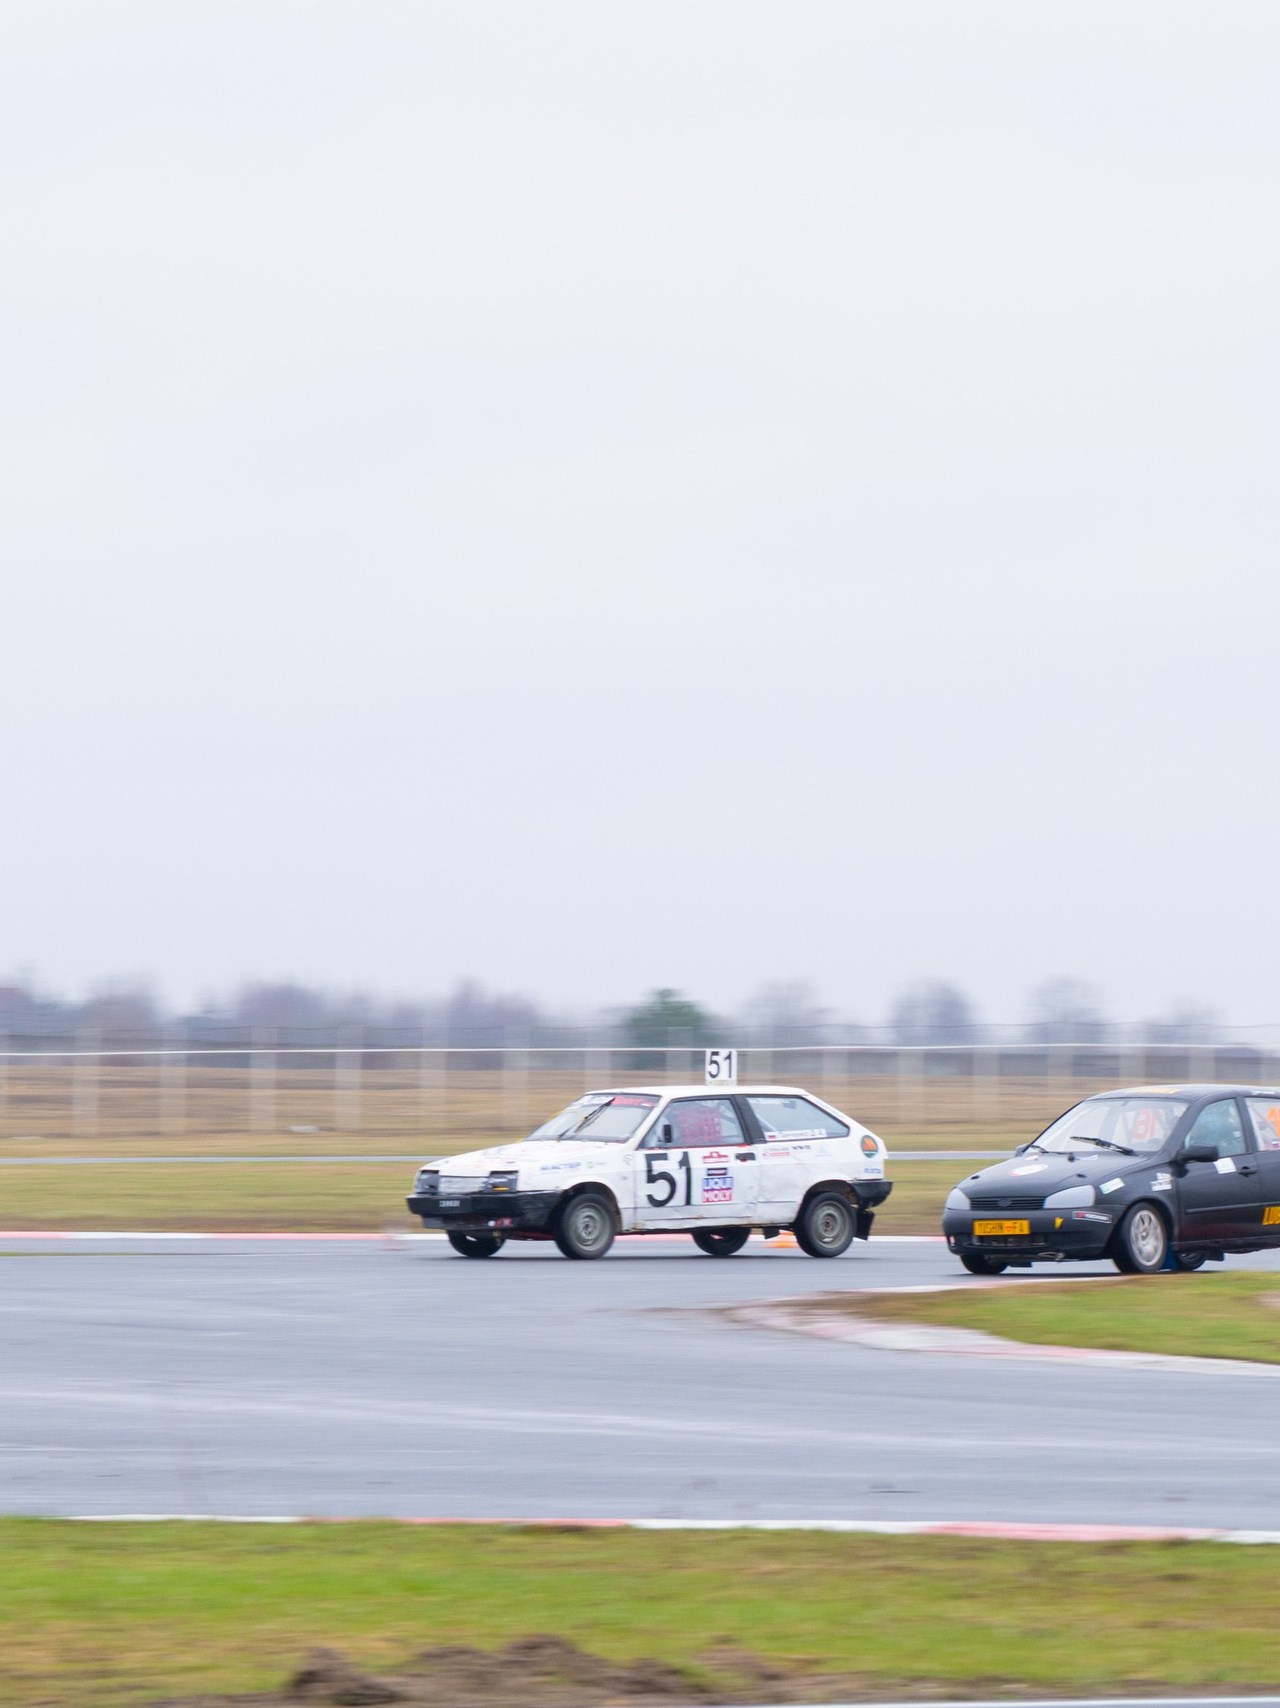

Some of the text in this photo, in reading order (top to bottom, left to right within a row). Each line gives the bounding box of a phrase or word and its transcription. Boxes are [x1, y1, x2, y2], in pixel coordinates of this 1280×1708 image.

[708, 1051, 732, 1079] 51
[644, 1151, 692, 1208] 51
[702, 1177, 733, 1190] LIQUI
[702, 1190, 732, 1203] MOLY
